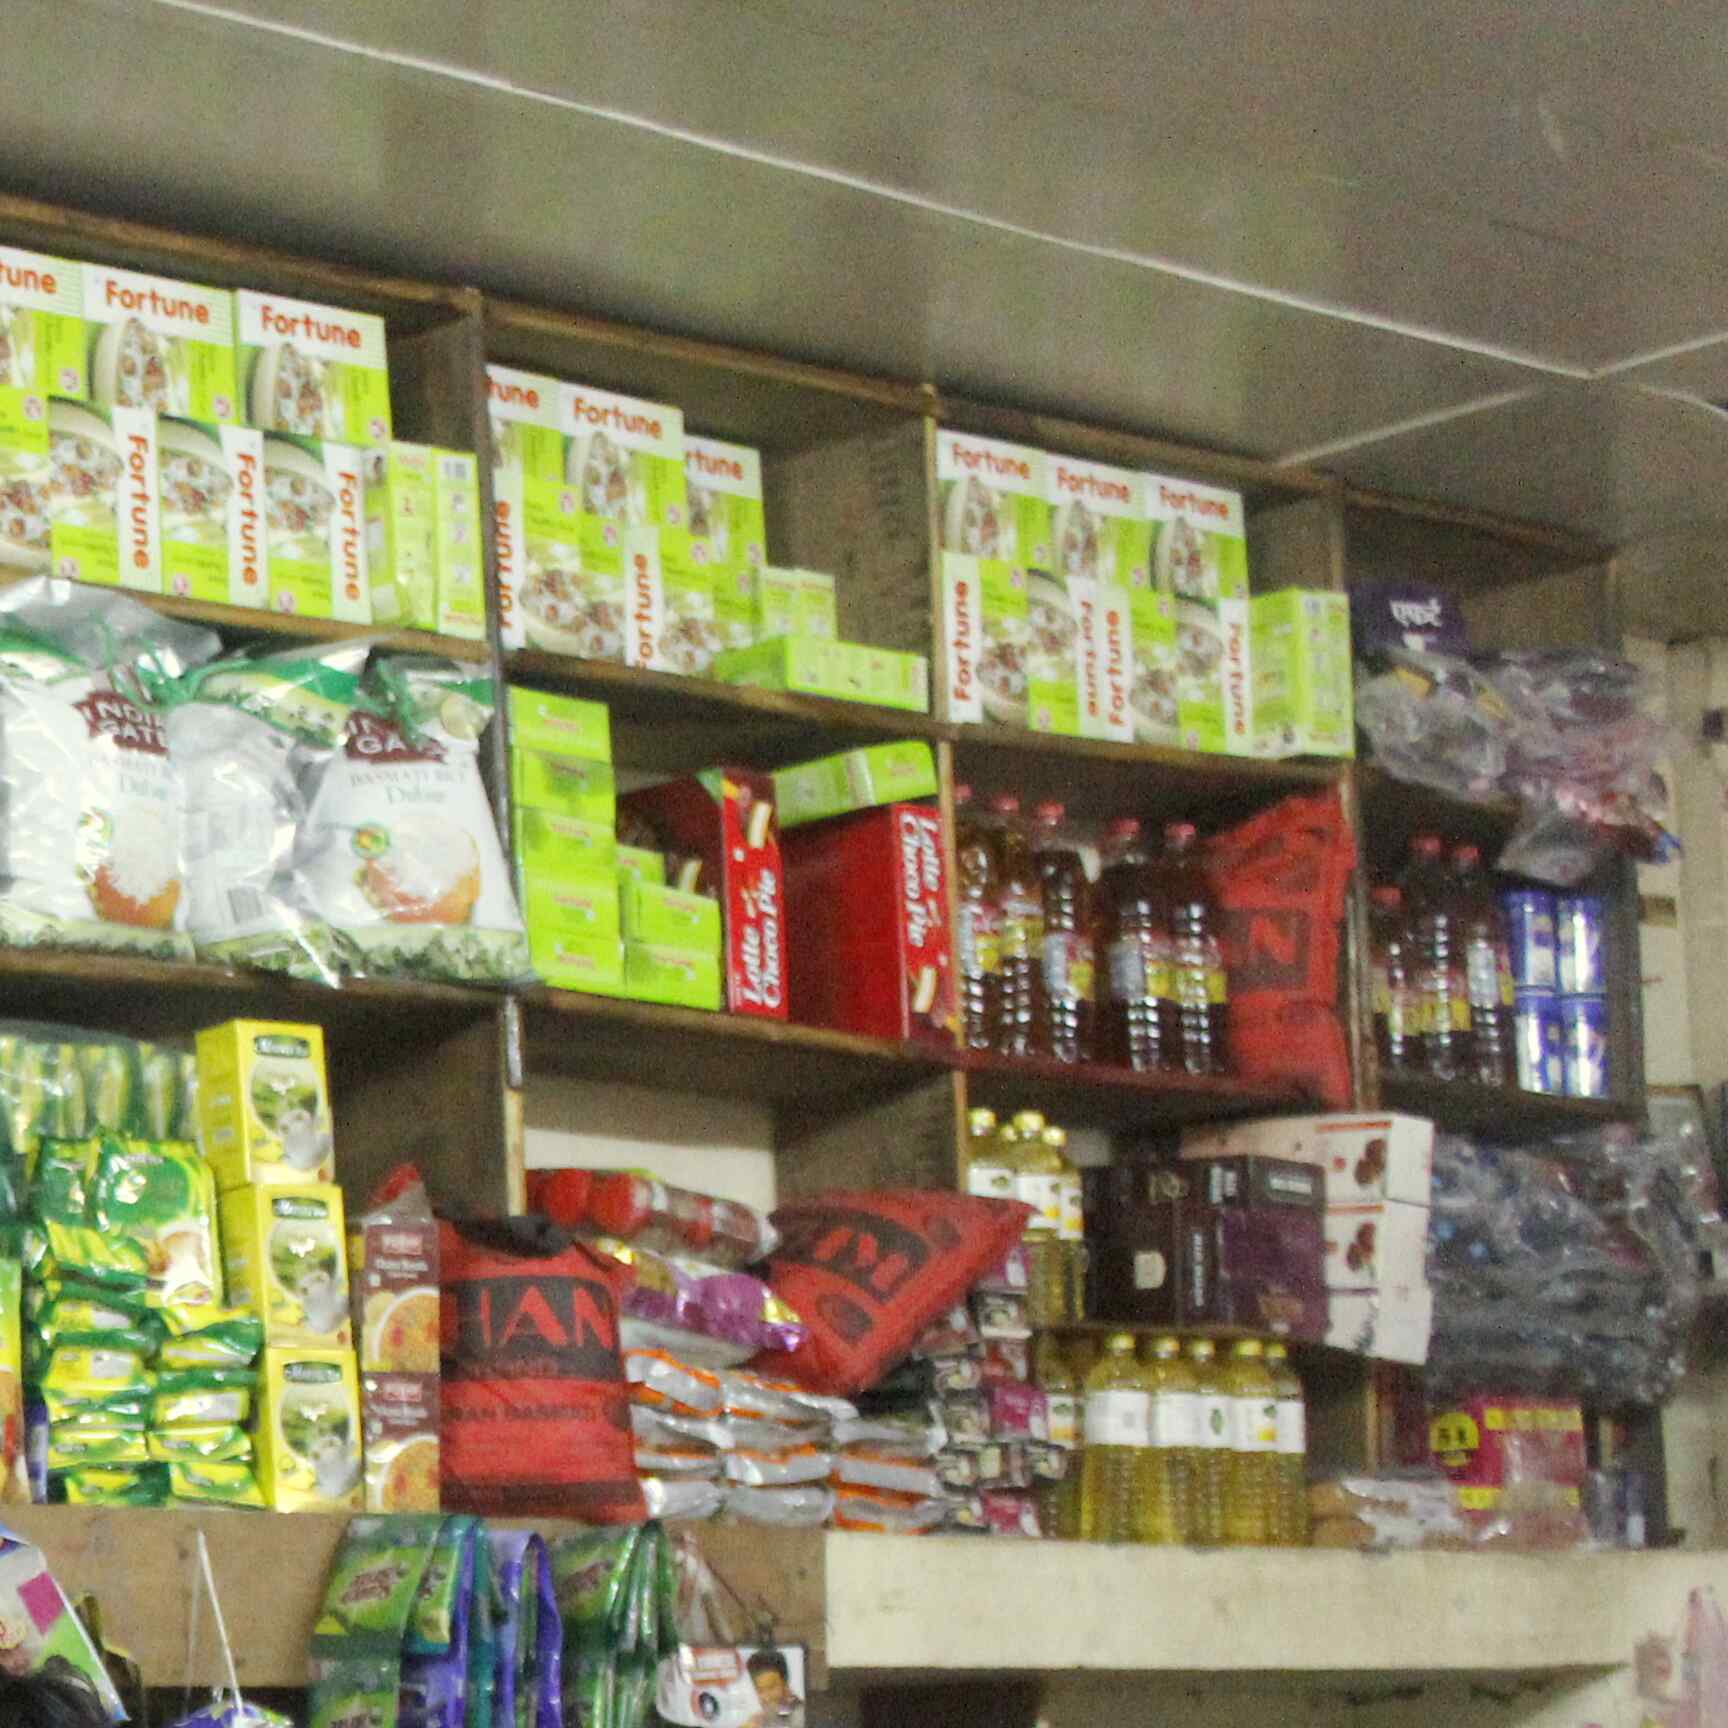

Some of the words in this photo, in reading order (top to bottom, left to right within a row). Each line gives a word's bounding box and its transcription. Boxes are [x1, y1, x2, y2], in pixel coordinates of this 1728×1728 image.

[104, 279, 210, 326] Fortune
[260, 306, 362, 350] Fortune
[487, 382, 540, 411] tune
[572, 398, 664, 441] Fortune
[686, 451, 744, 482] rtune
[952, 441, 1032, 483] Fortune
[1056, 466, 1131, 505] Fortune
[127, 434, 149, 571] Fortune
[236, 452, 259, 588] Fortune
[336, 470, 361, 603] Fortune
[1158, 485, 1232, 522] Fortune
[953, 581, 973, 704] Fortune
[1080, 601, 1100, 717] Fortune
[1107, 610, 1128, 728] Fortune
[899, 811, 921, 900] Choco
[761, 915, 782, 1008] Choco
